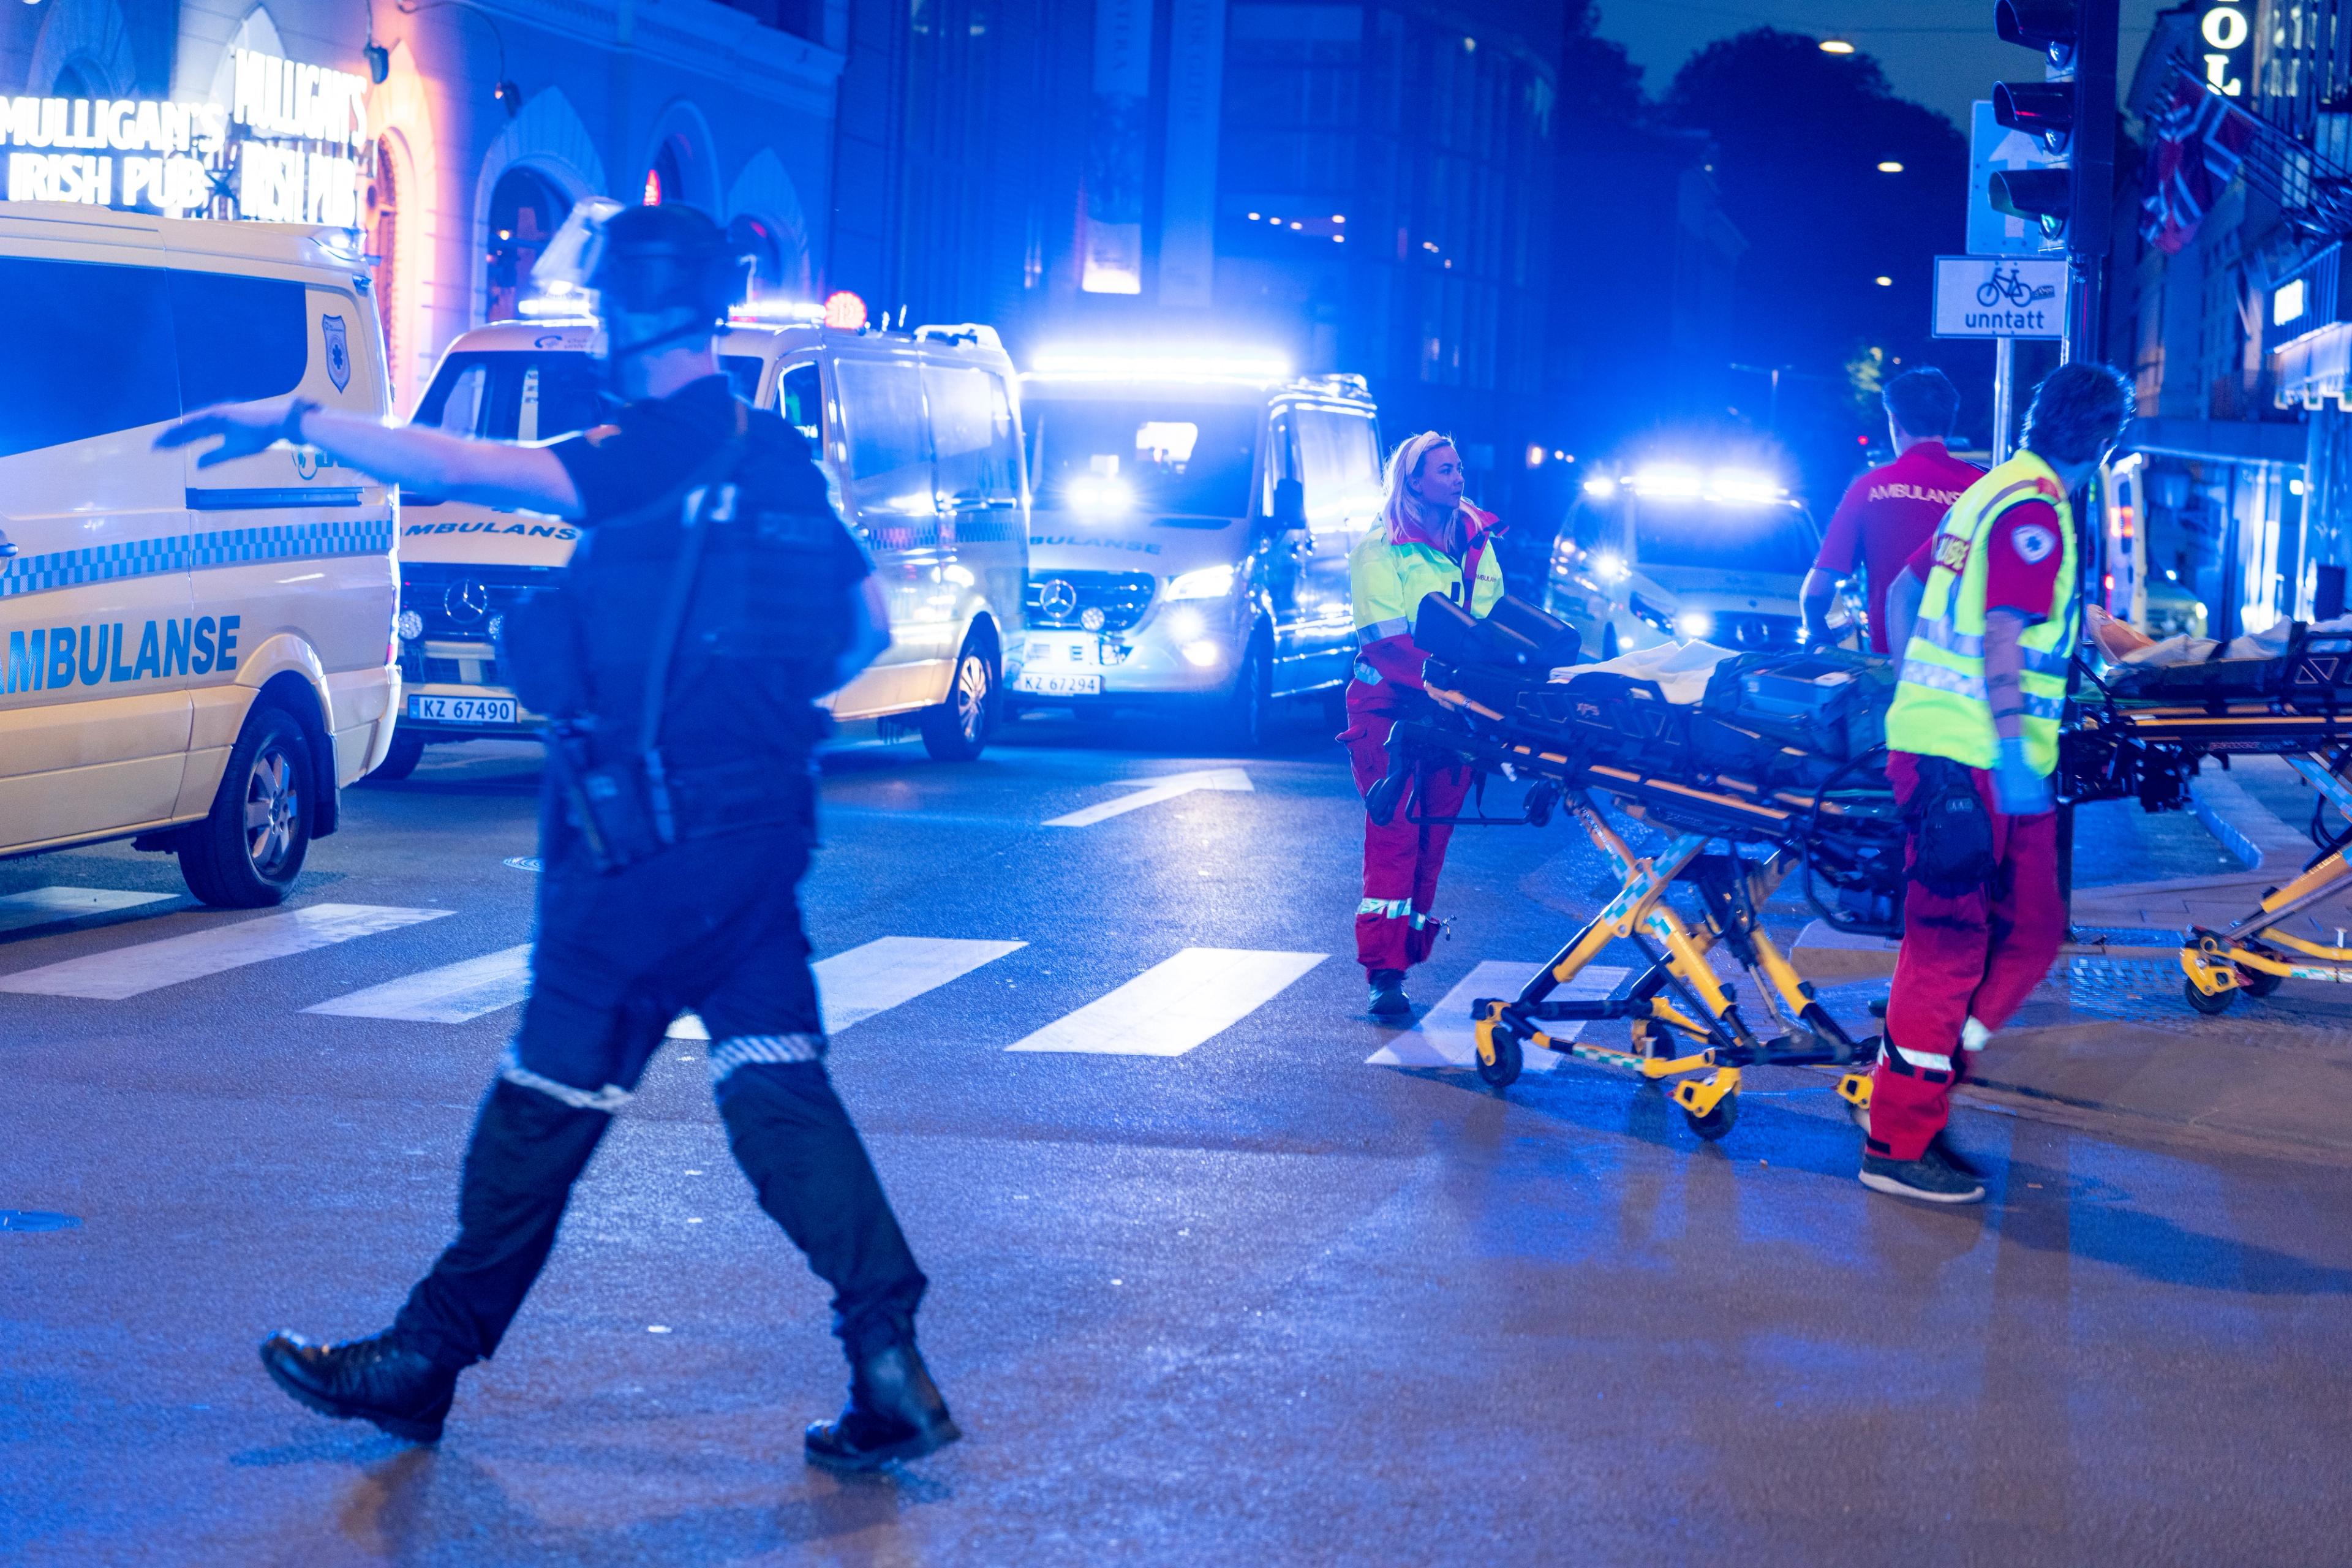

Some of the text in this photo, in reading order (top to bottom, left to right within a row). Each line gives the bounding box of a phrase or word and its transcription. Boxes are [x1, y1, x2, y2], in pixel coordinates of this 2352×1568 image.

[2201, 0, 2248, 97] OL
[0, 96, 225, 153] MULLIGAN'S
[9, 153, 209, 208] IRISH PUB
[1965, 310, 2045, 329] unntatt
[1869, 483, 1963, 506] AMBULANS
[401, 522, 577, 540] MBULANS
[1030, 536, 1161, 555] BULANSE
[1025, 676, 1095, 692] KZ 67294
[424, 699, 510, 720] KZ 67490
